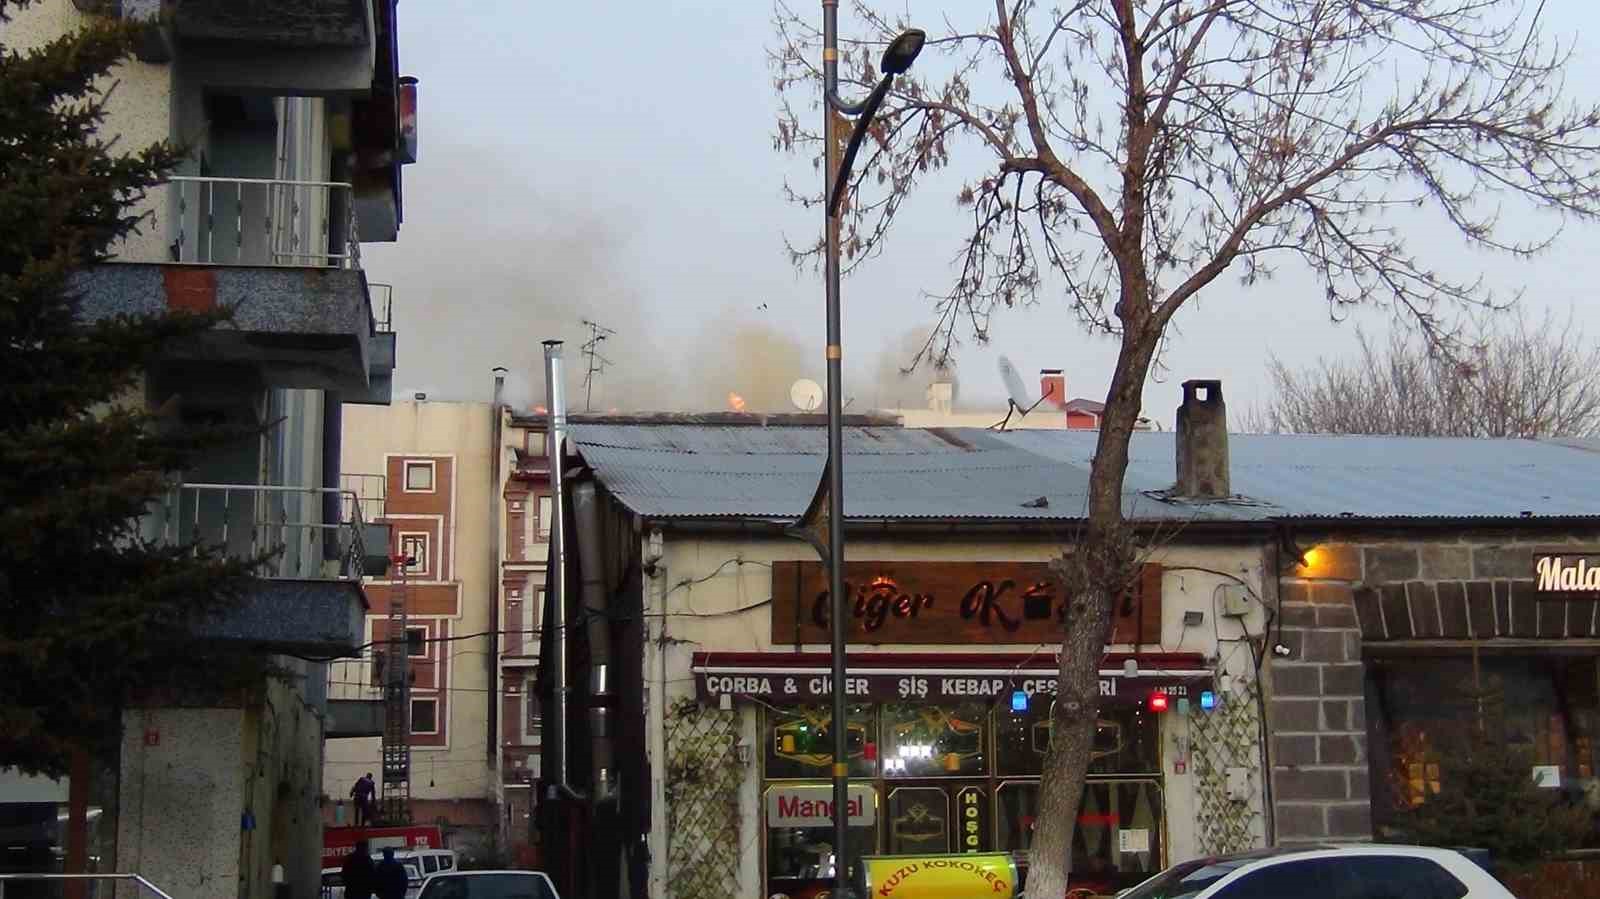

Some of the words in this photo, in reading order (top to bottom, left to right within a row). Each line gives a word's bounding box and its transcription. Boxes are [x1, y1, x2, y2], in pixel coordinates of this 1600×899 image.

[706, 676, 772, 696] ÇORBA
[783, 678, 798, 694] &
[808, 676, 870, 695] CİER
[898, 676, 929, 698] ŞİŞ
[941, 678, 1004, 696] KEBAP
[778, 794, 863, 819] Manal
[965, 793, 978, 853] HOŞG
[879, 863, 919, 897] KUZU
